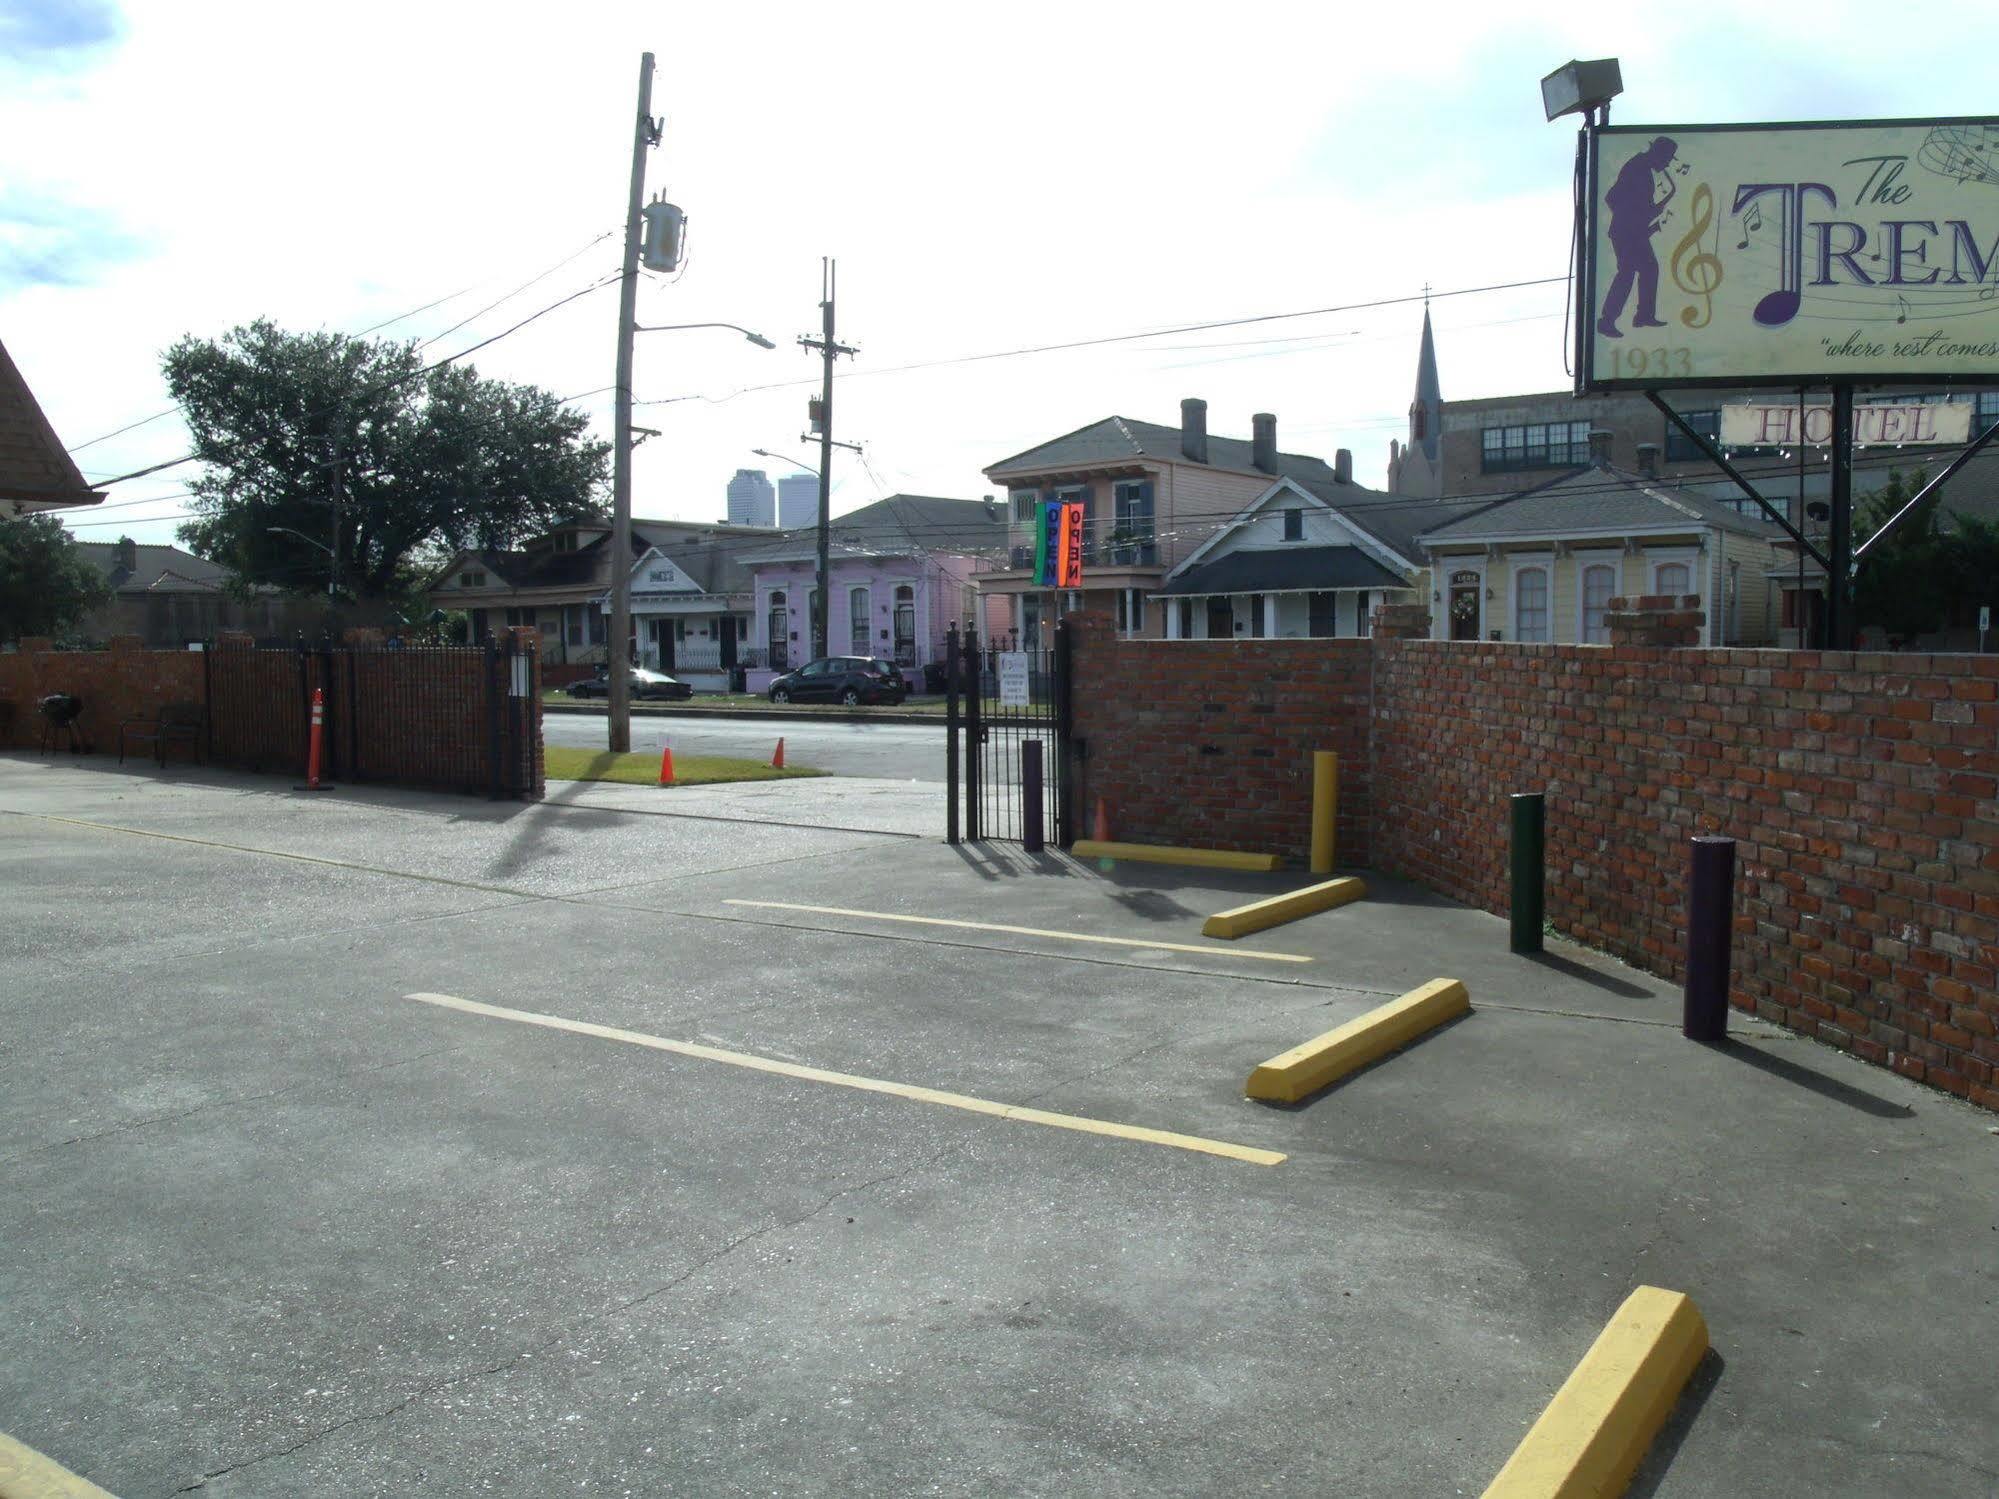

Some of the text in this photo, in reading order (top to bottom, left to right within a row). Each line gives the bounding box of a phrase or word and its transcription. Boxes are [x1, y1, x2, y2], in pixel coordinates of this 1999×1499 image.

[1841, 155, 1913, 206] The
[1892, 329, 1951, 357] rest
[1936, 342, 1999, 357] comes
[1609, 347, 1693, 379] 1933
[1754, 406, 1938, 443] HOTEL
[1048, 509, 1059, 578] OPEN
